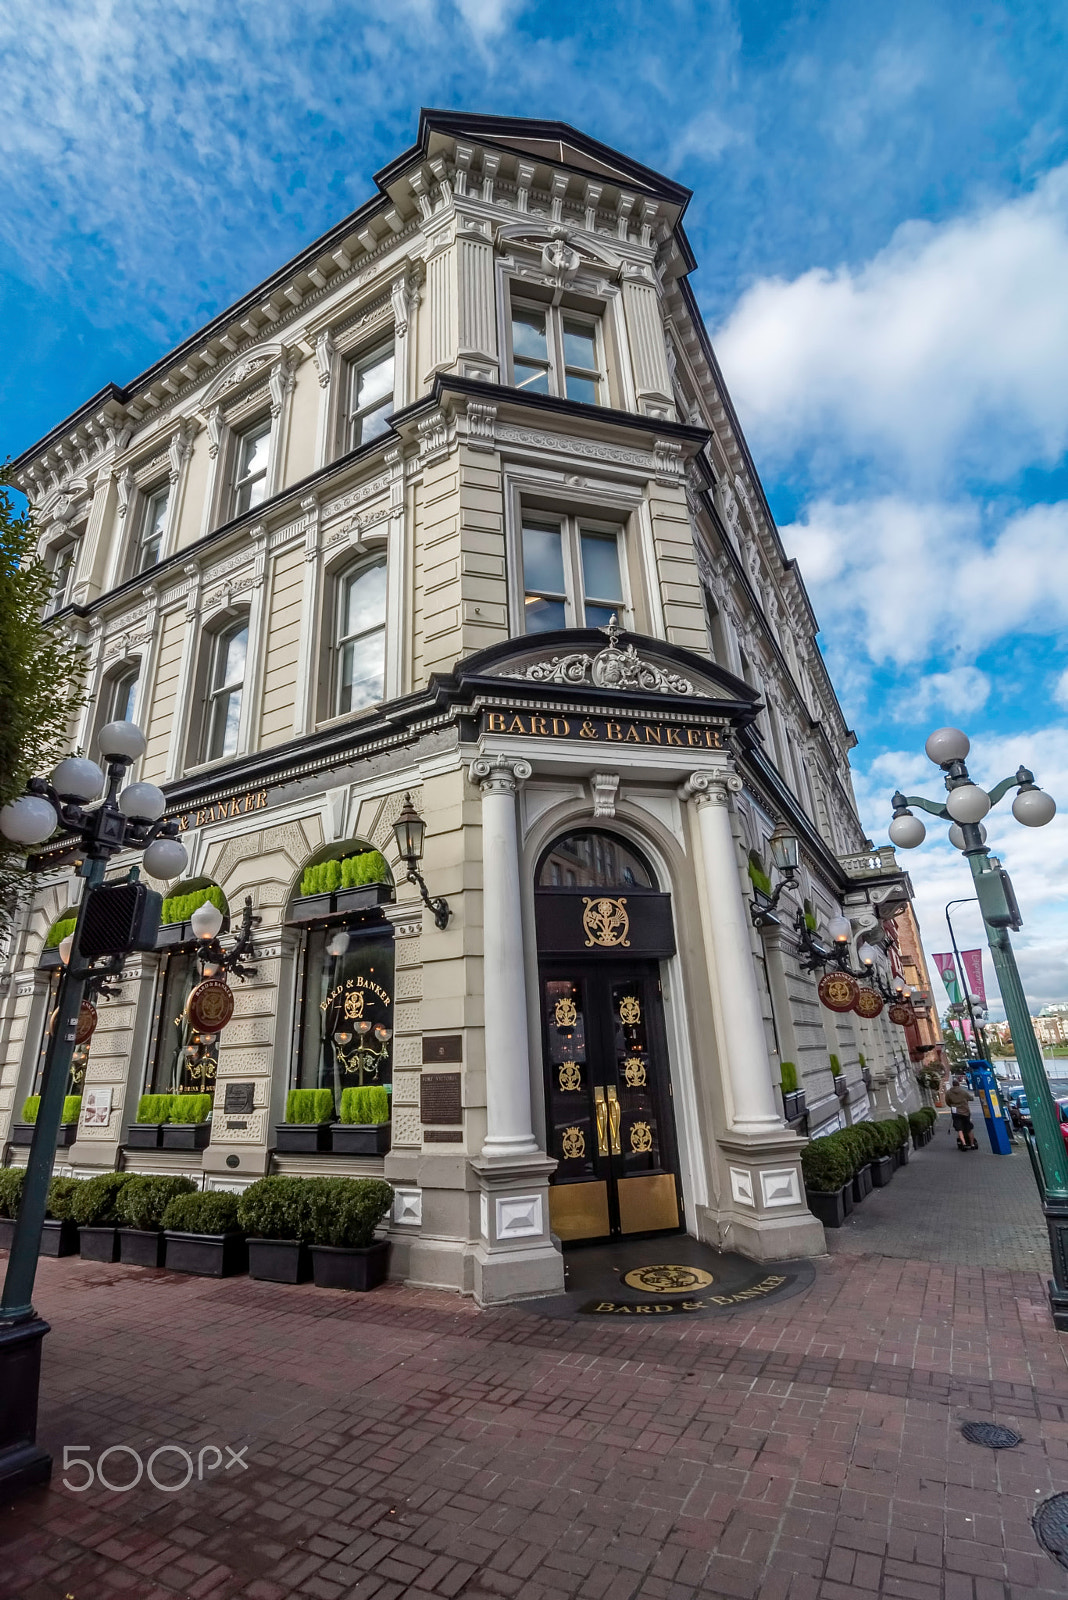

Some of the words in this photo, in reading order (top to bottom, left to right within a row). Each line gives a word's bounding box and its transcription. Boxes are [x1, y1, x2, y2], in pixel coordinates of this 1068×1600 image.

[487, 712, 570, 737] BARD
[579, 720, 598, 739] &
[603, 721, 723, 748] BANKER
[178, 815, 188, 831] &
[195, 792, 267, 827] BANKER
[320, 985, 343, 1010] BARD
[346, 980, 354, 988] &
[356, 976, 390, 1007] BANKER
[595, 1303, 673, 1314] BARD
[682, 1302, 708, 1310] &
[710, 1275, 787, 1306] BANKER
